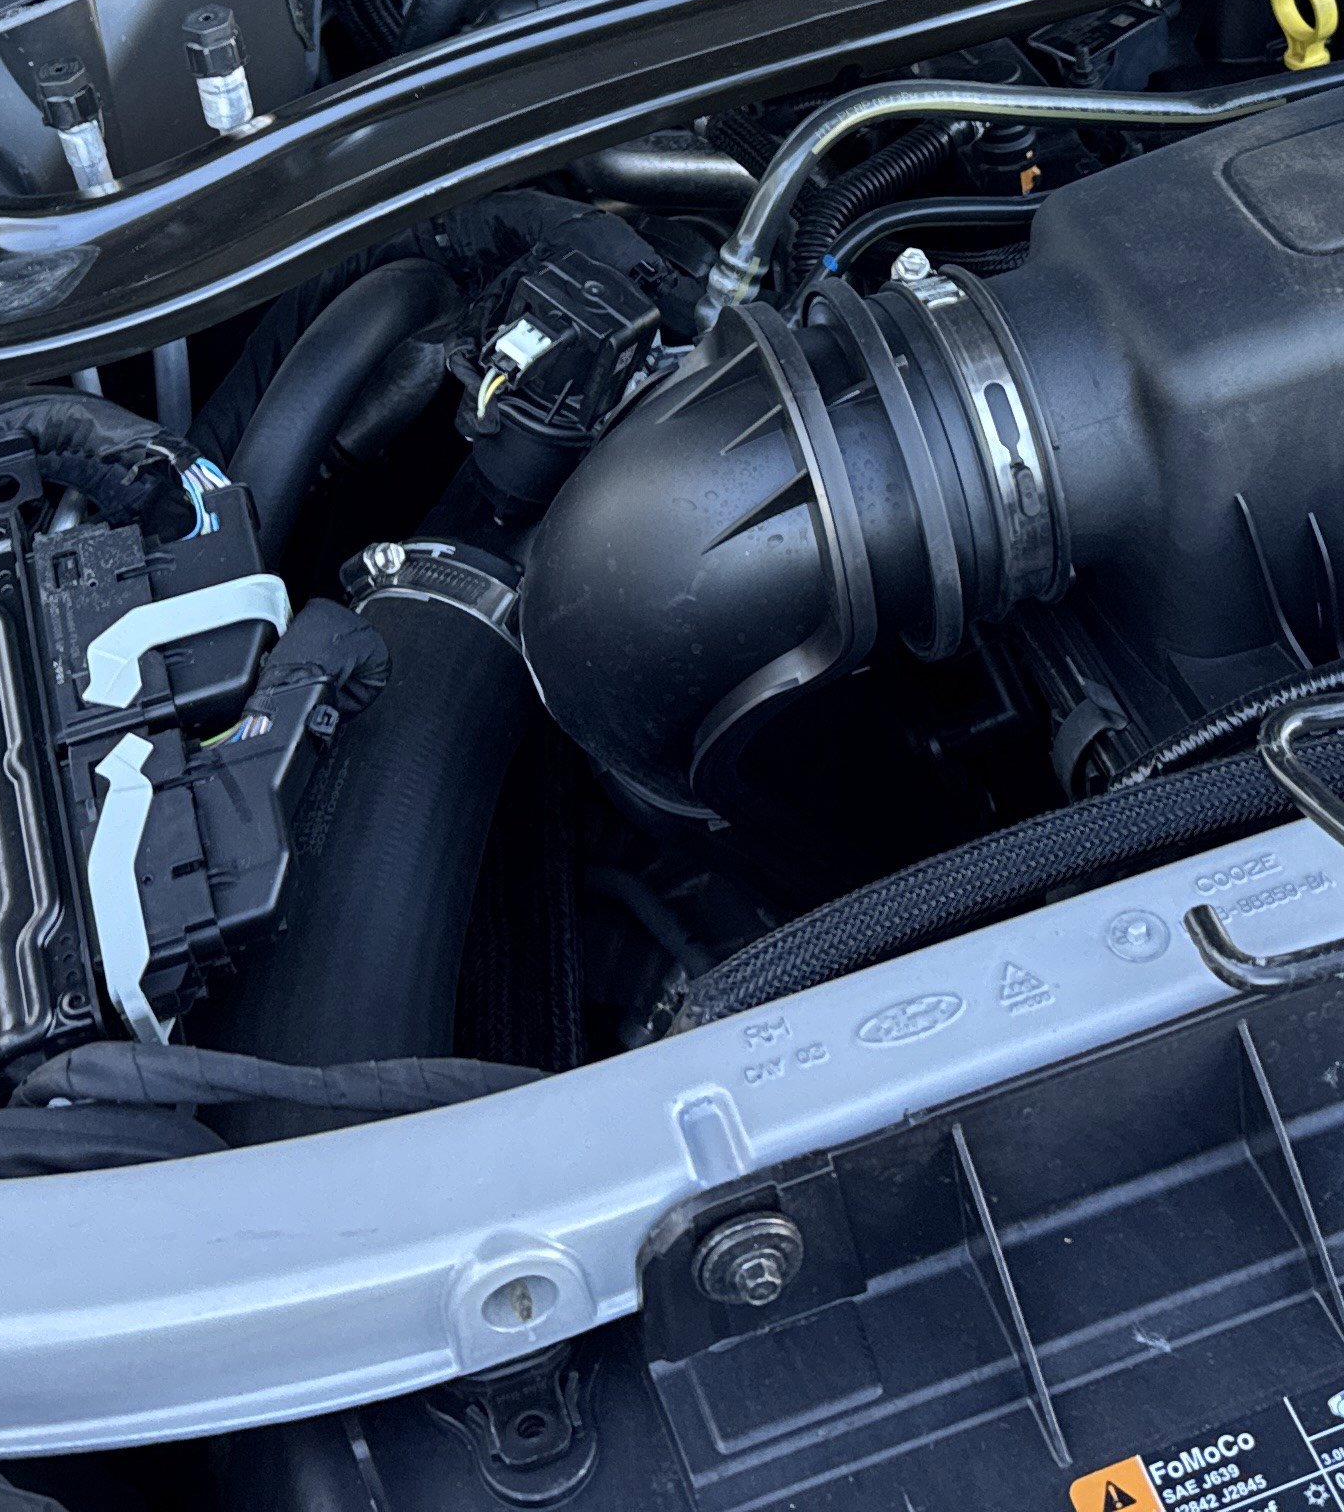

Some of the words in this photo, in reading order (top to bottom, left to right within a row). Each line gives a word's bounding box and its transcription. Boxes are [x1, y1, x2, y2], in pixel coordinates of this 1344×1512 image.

[1149, 1432, 1256, 1486] FoMoCo
[1162, 1479, 1201, 1504] SAE
[1202, 1463, 1240, 1490] J639
[1221, 1473, 1267, 1503] J2845
